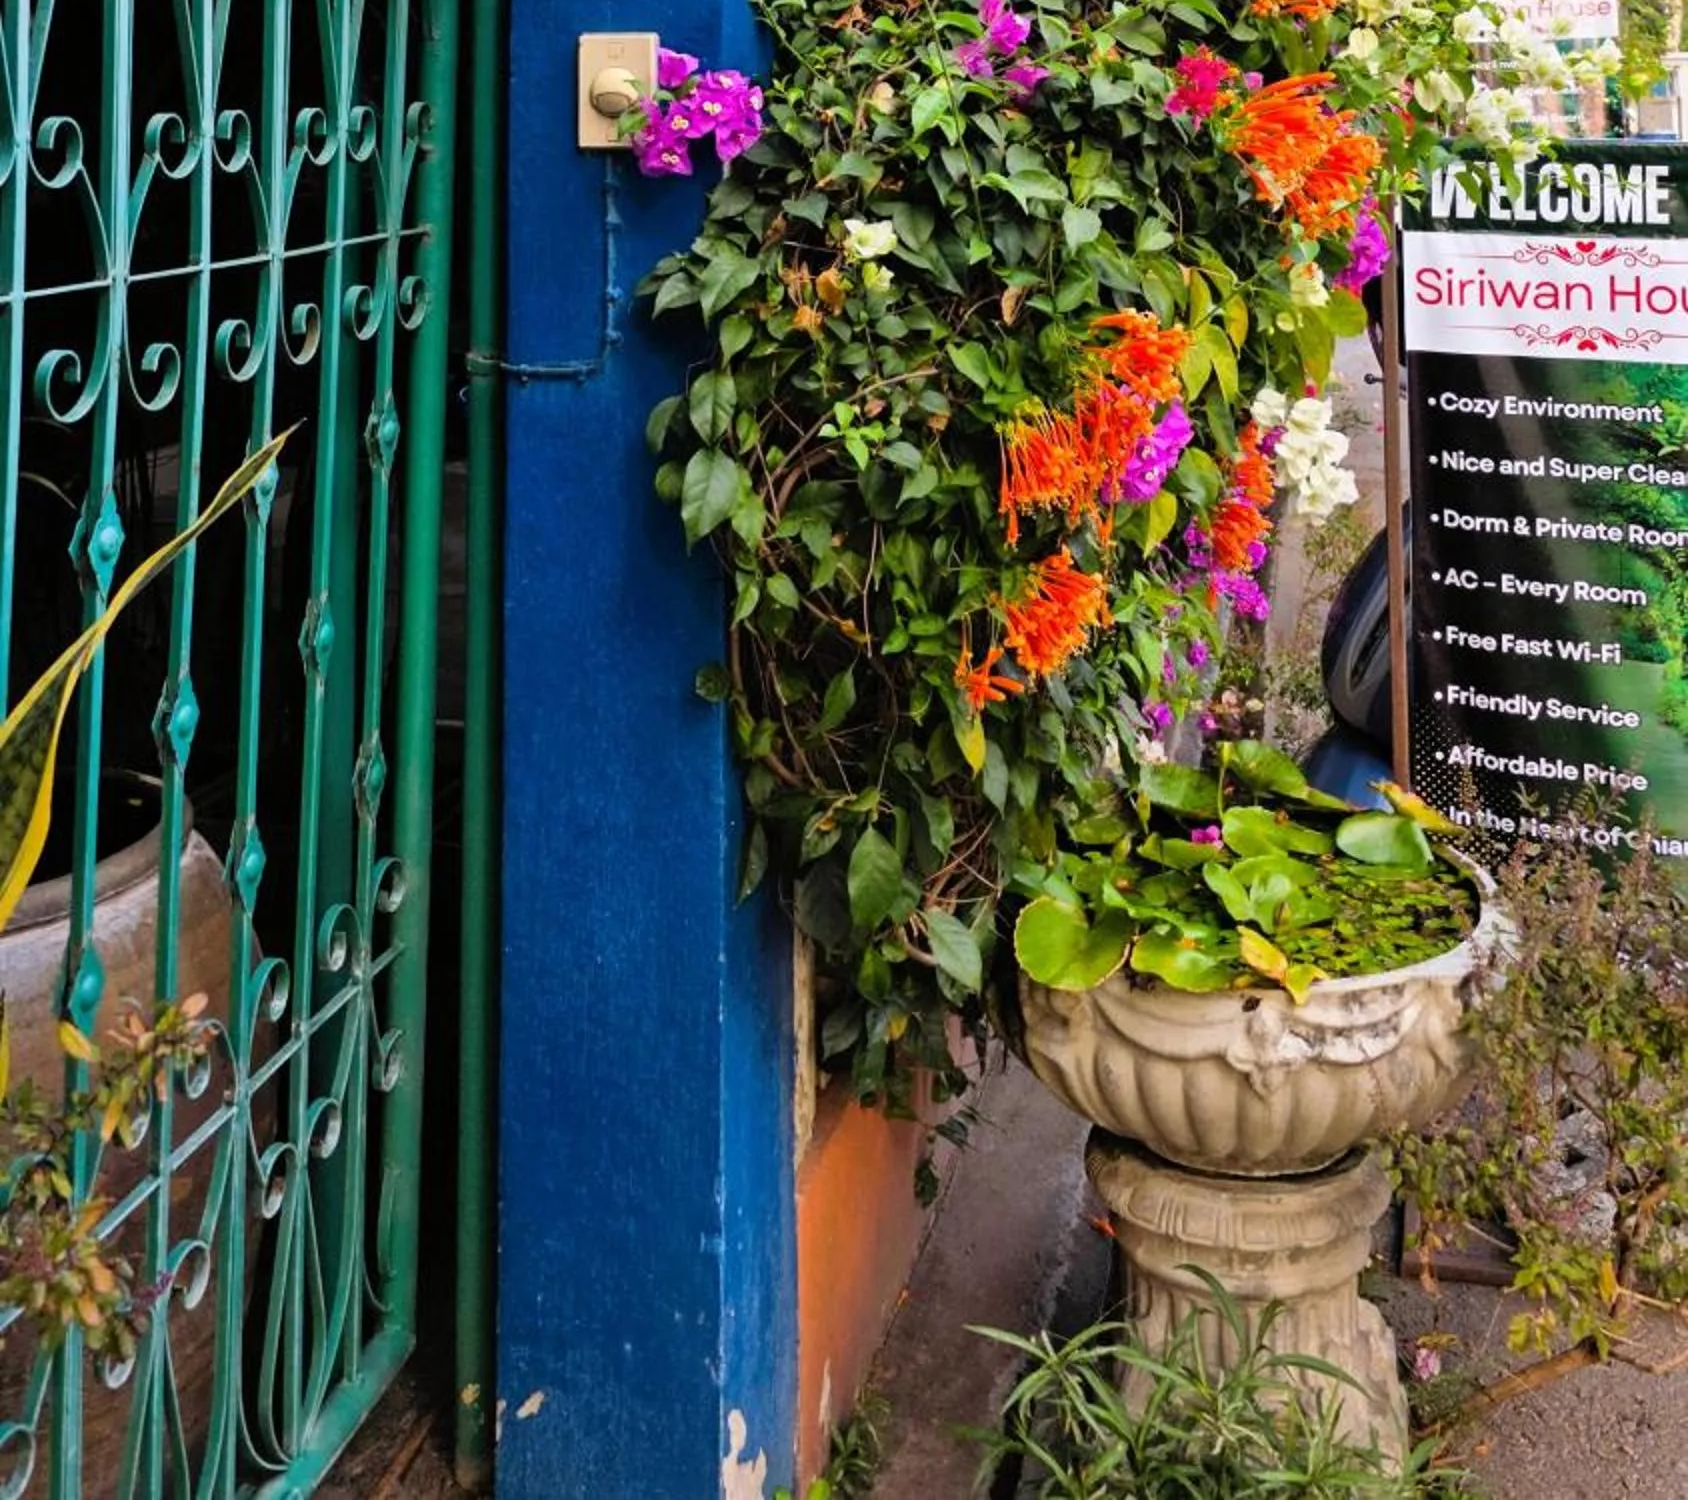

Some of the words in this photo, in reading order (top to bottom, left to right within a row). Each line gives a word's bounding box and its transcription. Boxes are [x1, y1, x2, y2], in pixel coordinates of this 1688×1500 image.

[1430, 160, 1671, 225] WELCOME
[1414, 267, 1593, 312] Siriwan
[1439, 391, 1500, 419] Cozy
[1504, 396, 1663, 423] Environment
[1442, 450, 1495, 473] Nice
[1500, 456, 1545, 477] and
[1550, 457, 1624, 483] Super
[1628, 463, 1688, 487] Clea
[1443, 509, 1508, 533] Dorm
[1513, 515, 1531, 536] &
[1535, 517, 1623, 542] Private
[1444, 567, 1479, 589] AC
[1501, 573, 1569, 603] Every
[1573, 581, 1648, 606] Room
[1446, 626, 1497, 651] Free
[1501, 634, 1552, 657] Fast
[1556, 639, 1622, 665] Wi-Fi
[1447, 685, 1543, 720] Friendly
[1546, 698, 1641, 728] Service
[1448, 745, 1579, 780] Affordable
[1583, 763, 1649, 791] Price
[1449, 805, 1472, 826] In
[1594, 826, 1623, 847] of
